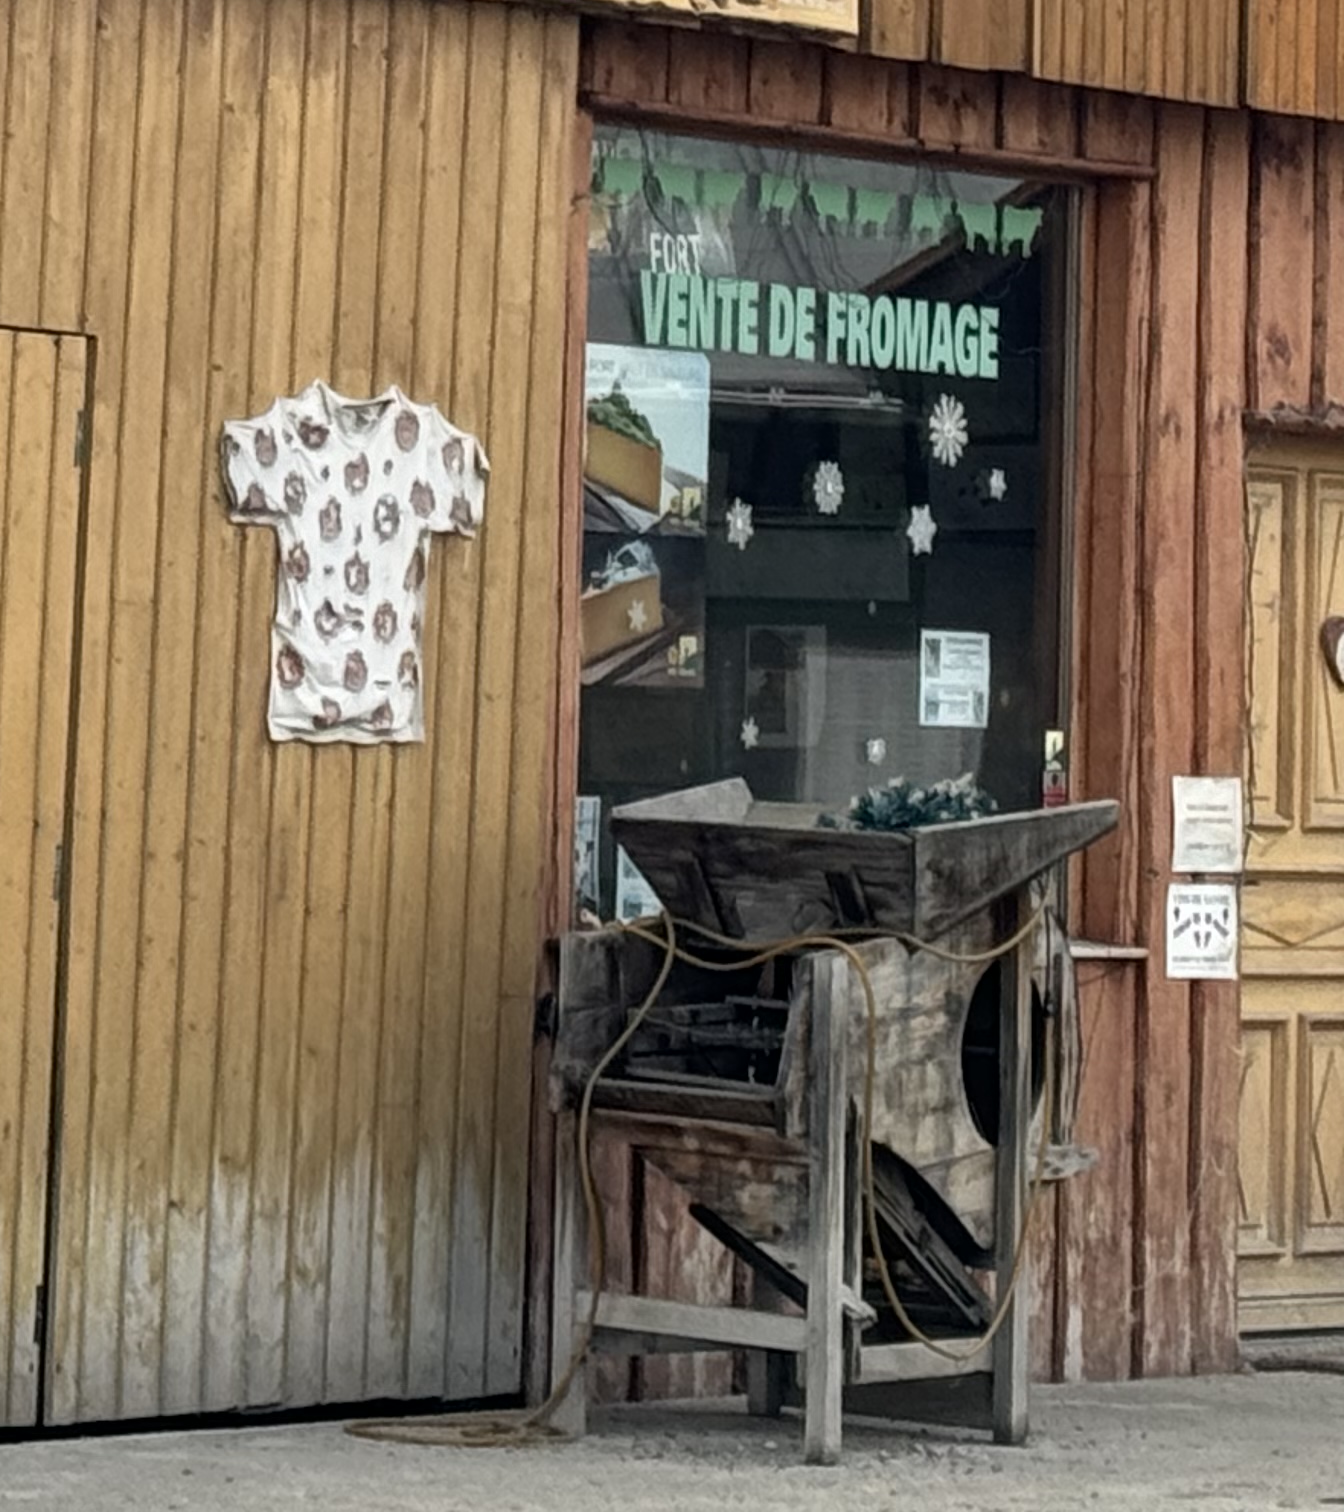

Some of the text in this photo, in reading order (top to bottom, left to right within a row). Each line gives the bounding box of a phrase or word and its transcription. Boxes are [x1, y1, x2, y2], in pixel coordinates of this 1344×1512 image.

[641, 270, 1000, 379] VENTE DE FROMAGE
